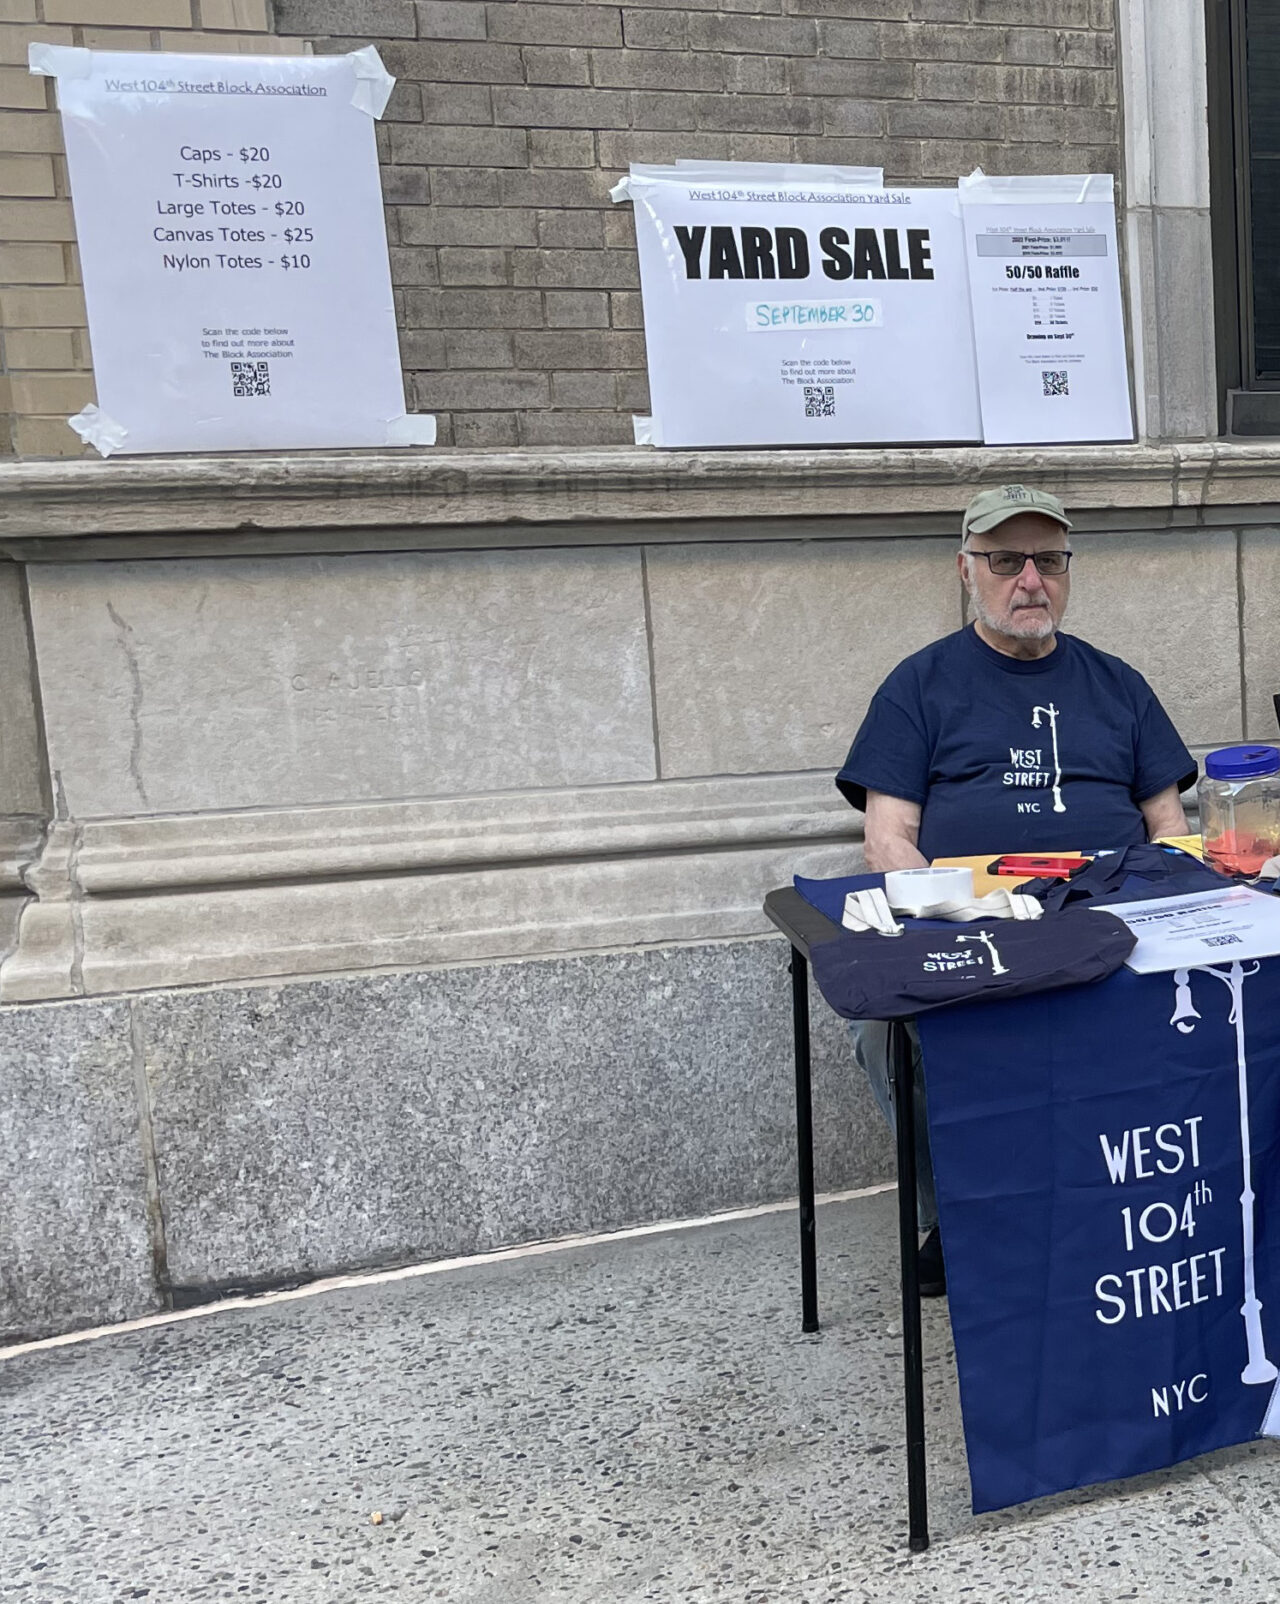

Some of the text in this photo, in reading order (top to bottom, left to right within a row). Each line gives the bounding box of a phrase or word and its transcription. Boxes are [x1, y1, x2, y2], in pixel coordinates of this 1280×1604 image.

[105, 79, 137, 91] West
[178, 80, 215, 93] Street
[217, 82, 252, 94] Block
[255, 82, 327, 96] Association
[180, 146, 221, 164] Caps
[239, 147, 270, 164] $20
[174, 173, 239, 189] T-Shirts
[689, 190, 715, 200] West
[747, 191, 777, 202] Street
[778, 192, 806, 202] Block
[808, 192, 865, 203] Association
[867, 194, 890, 204] Yard
[892, 194, 911, 204] Sale
[157, 200, 205, 218] Large
[209, 201, 256, 215] Totes
[275, 201, 305, 217] $20
[153, 227, 214, 242] Canvas
[218, 227, 265, 242] Totes
[284, 228, 314, 244] $25
[673, 225, 935, 281] YARD SALE
[163, 254, 210, 272] Nylon
[215, 254, 262, 269] Totes
[280, 254, 311, 271] $10
[1005, 265, 1080, 279] 50/50 Raffle
[756, 304, 874, 326] SEPTEMBER 30
[202, 328, 223, 336] Scan
[241, 328, 261, 336] code
[264, 328, 288, 336] below
[201, 340, 210, 348] to
[212, 339, 228, 347] find
[271, 339, 295, 347] about
[222, 350, 244, 358] Block
[246, 350, 293, 358] Association
[831, 359, 851, 367] below
[1009, 747, 1042, 767] WEST
[1017, 803, 1041, 814] NYC
[1099, 1116, 1203, 1184] WEST
[1121, 1180, 1212, 1251] 104th
[1095, 1247, 1226, 1324] STREET
[1151, 1374, 1208, 1418] NYC
